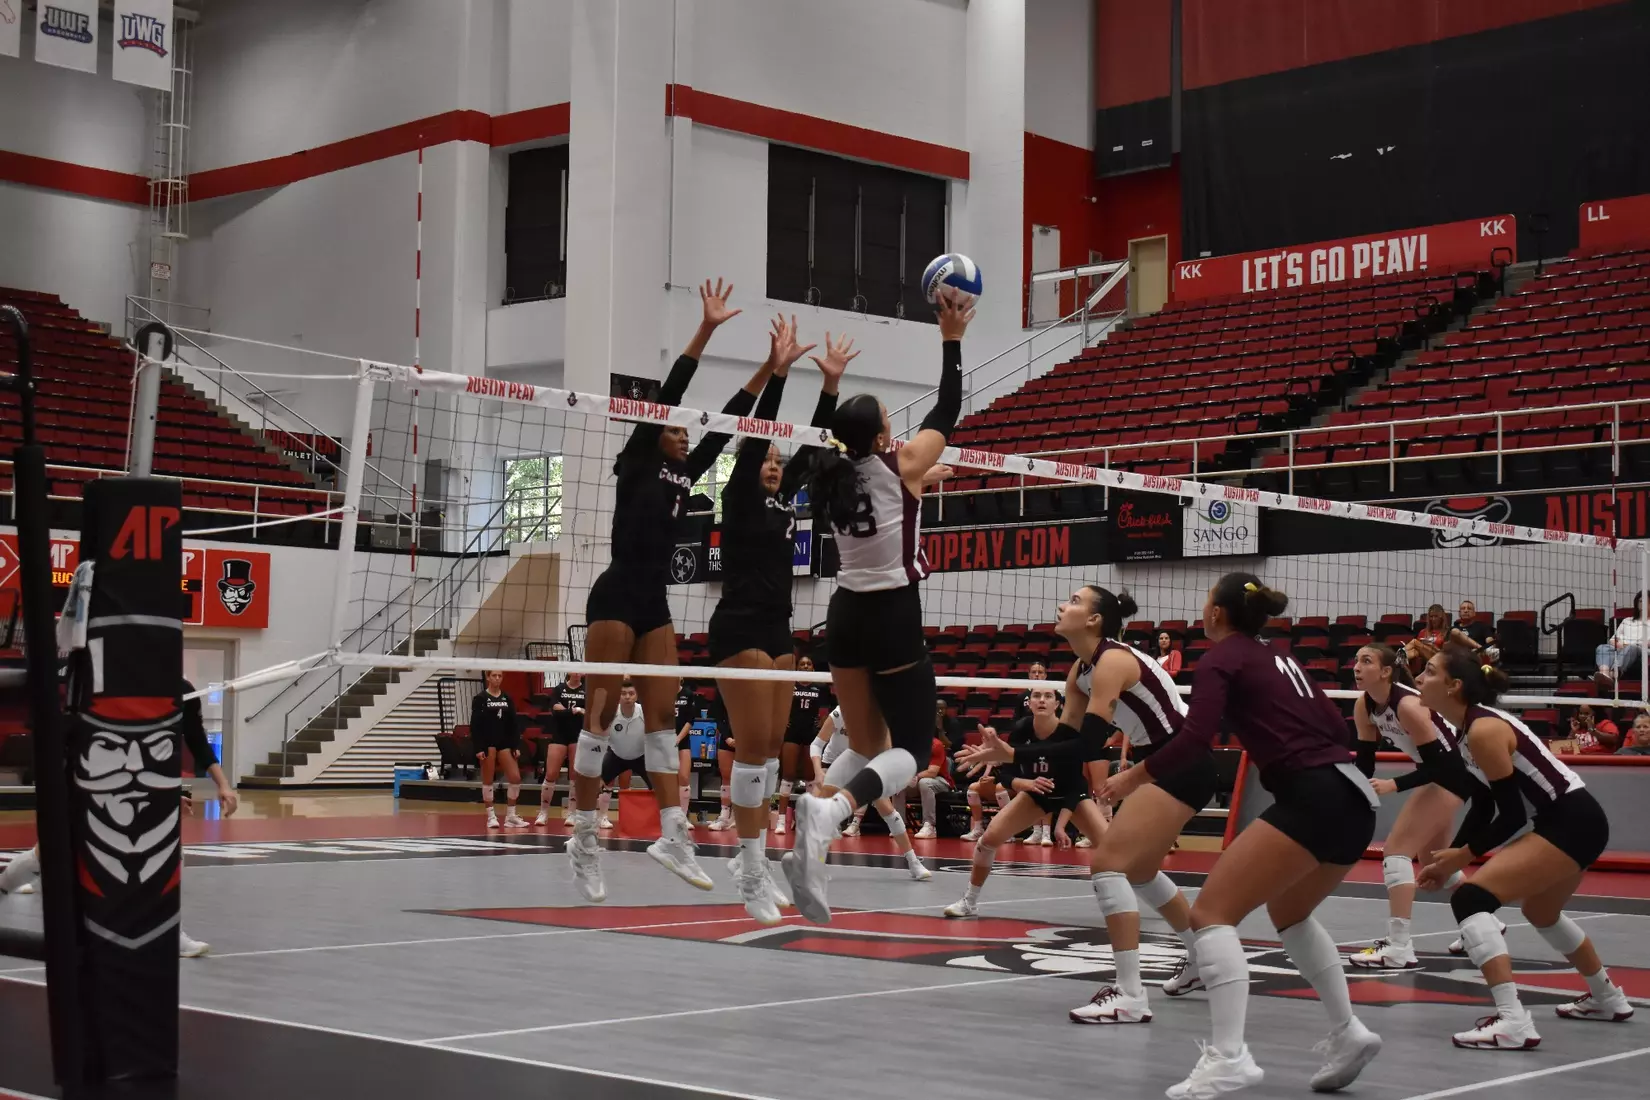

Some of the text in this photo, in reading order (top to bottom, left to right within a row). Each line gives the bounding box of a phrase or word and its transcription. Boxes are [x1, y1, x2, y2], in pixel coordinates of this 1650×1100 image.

[46, 7, 89, 34] UWF
[122, 15, 164, 44] UWG
[1587, 205, 1610, 222] LL
[1480, 219, 1506, 237] KK
[1180, 263, 1203, 280] KK
[1242, 233, 1429, 293] LET'S GO PEAY!
[466, 375, 536, 401] AUSTIN PEAY
[608, 397, 671, 421] AUSTIN PEAY
[736, 415, 794, 438] AUSTIN PEAY
[958, 448, 1006, 468] AUSTIN PEAY
[1054, 462, 1098, 481] AUSTIN PEAY
[1142, 474, 1183, 492] AUSTIN PEAY
[1223, 485, 1260, 502] AUSTIN PEAY
[1297, 496, 1318, 510] AUSTIN
[1545, 490, 1650, 539] AUSTI
[108, 505, 181, 560] AP
[1193, 525, 1249, 543] SANGO
[1274, 655, 1315, 699] 11
[1033, 762, 1049, 773] 10
